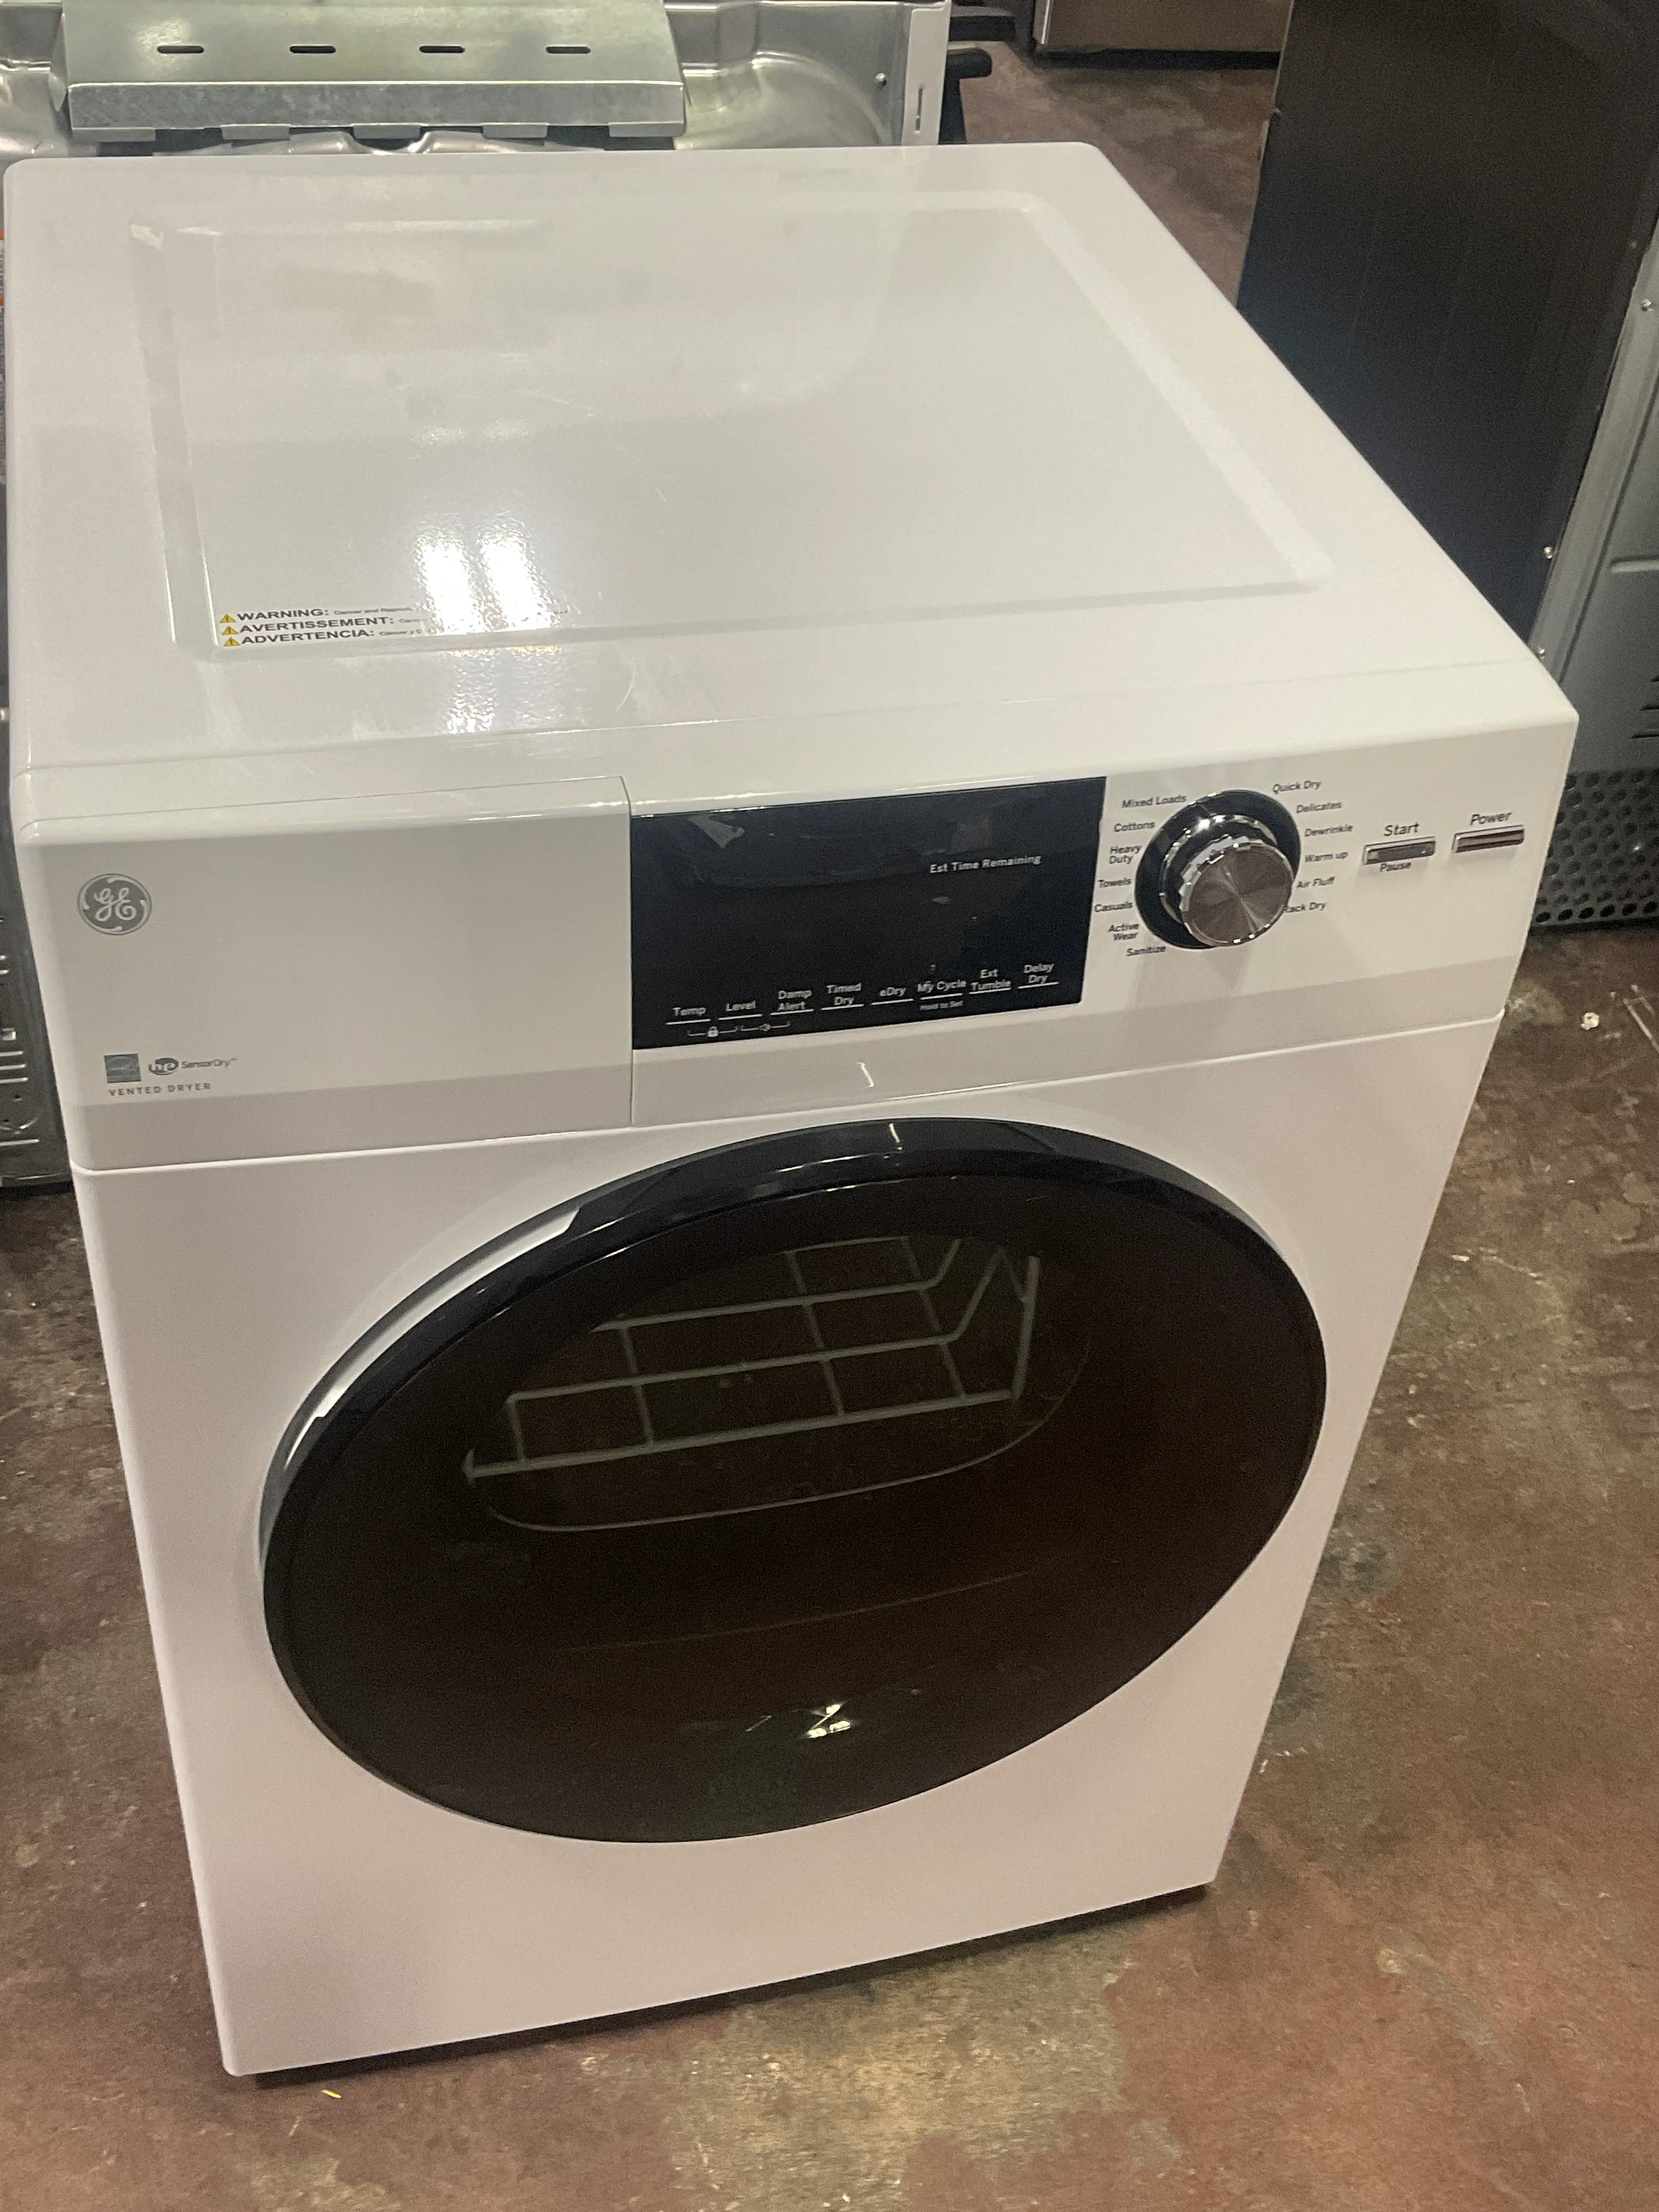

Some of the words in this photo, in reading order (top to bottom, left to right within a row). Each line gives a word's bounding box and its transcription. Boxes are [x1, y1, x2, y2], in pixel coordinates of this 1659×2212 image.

[237, 608, 329, 621] WARNING:
[240, 617, 394, 633] AVERTISSEMENT:
[241, 629, 374, 644] ADVERTENCIA:
[1272, 782, 1301, 793] Quick
[1303, 780, 1322, 791] Dry
[1122, 798, 1153, 809] Mixed
[1155, 795, 1187, 805] Loads
[1296, 802, 1342, 814] Delicates
[1470, 812, 1513, 825] Power
[1114, 821, 1155, 833] Cottons
[1304, 823, 1353, 837] Dewrinkle
[1384, 822, 1420, 837] Start
[1110, 845, 1142, 856] Heavy
[1305, 854, 1334, 862] Warm
[1336, 851, 1349, 860] up
[930, 864, 949, 873] Est
[951, 861, 980, 872] Time
[982, 855, 1042, 868] Remaining
[1109, 855, 1133, 865] Duty
[1379, 862, 1412, 872] Pause
[1099, 878, 1132, 889] Towels
[1296, 881, 1311, 889] Air
[1313, 877, 1335, 887] Fluff
[1094, 901, 1133, 913] Casuals
[1309, 901, 1327, 911] Dry
[1108, 922, 1139, 934] Active
[1113, 932, 1138, 941] Wear
[1126, 945, 1166, 957] Sanitize
[980, 968, 998, 979] Ext
[1023, 963, 1054, 974] Delay
[971, 979, 1011, 991] Tumble
[1028, 975, 1049, 984] Dry
[827, 983, 862, 994] Timed
[879, 986, 907, 997] eDry
[917, 981, 935, 994] My
[936, 979, 967, 992] Cycle
[778, 990, 812, 1000] Damp
[726, 1001, 756, 1012] Level
[777, 1001, 806, 1011] Alert
[834, 996, 855, 1007] Dry
[672, 1007, 707, 1016] Temp
[109, 1086, 162, 1096] VENTED
[167, 1082, 212, 1093] DRYER
